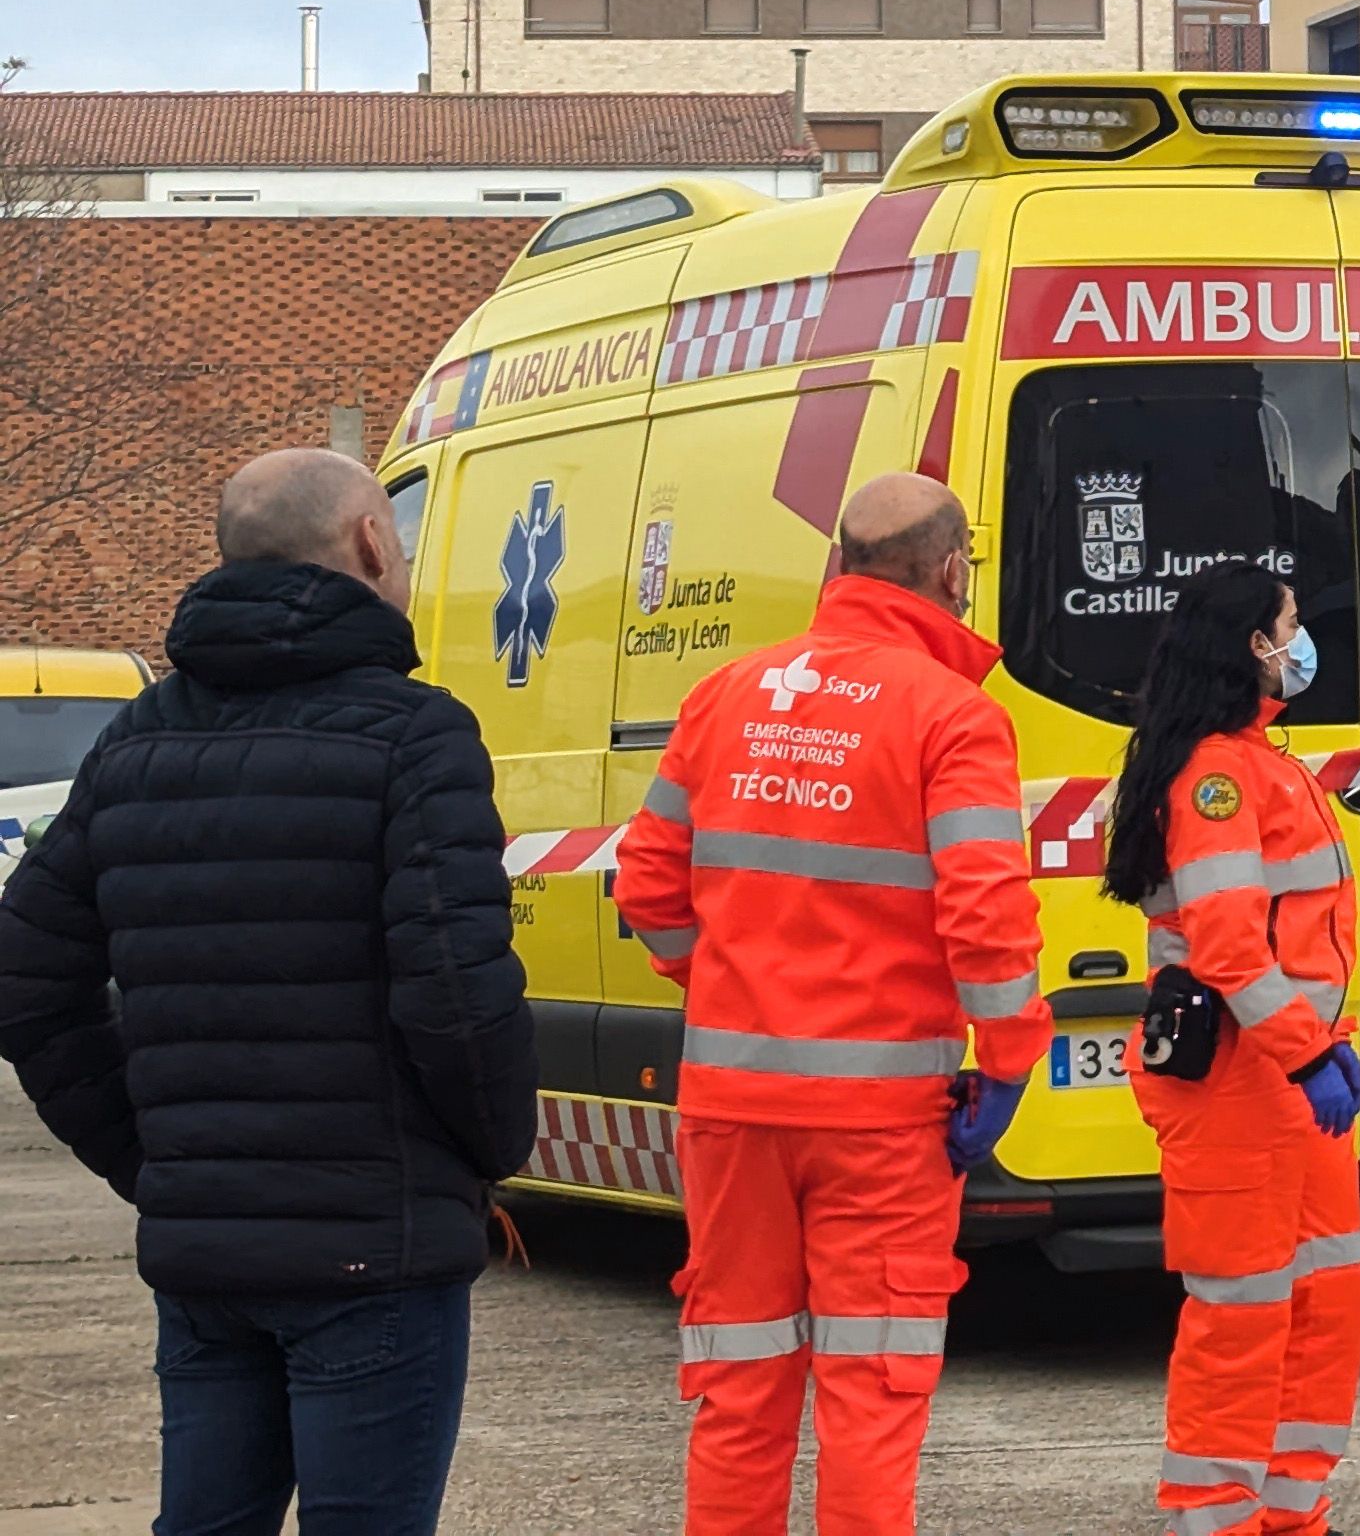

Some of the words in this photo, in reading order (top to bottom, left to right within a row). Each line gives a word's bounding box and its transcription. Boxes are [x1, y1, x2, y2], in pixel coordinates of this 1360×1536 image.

[483, 327, 653, 410] AMBULANCIA
[1256, 547, 1295, 575] de
[667, 578, 712, 609] Junta
[714, 572, 736, 604] de
[1064, 585, 1180, 615] Castilla
[625, 622, 676, 656] Castilla
[676, 626, 690, 662] y
[691, 616, 731, 650] León
[823, 675, 882, 704] Sacyl
[743, 721, 862, 750] EMERGENCIAS
[749, 741, 845, 767] SANITARIAS
[729, 767, 853, 812] TÉCNICO
